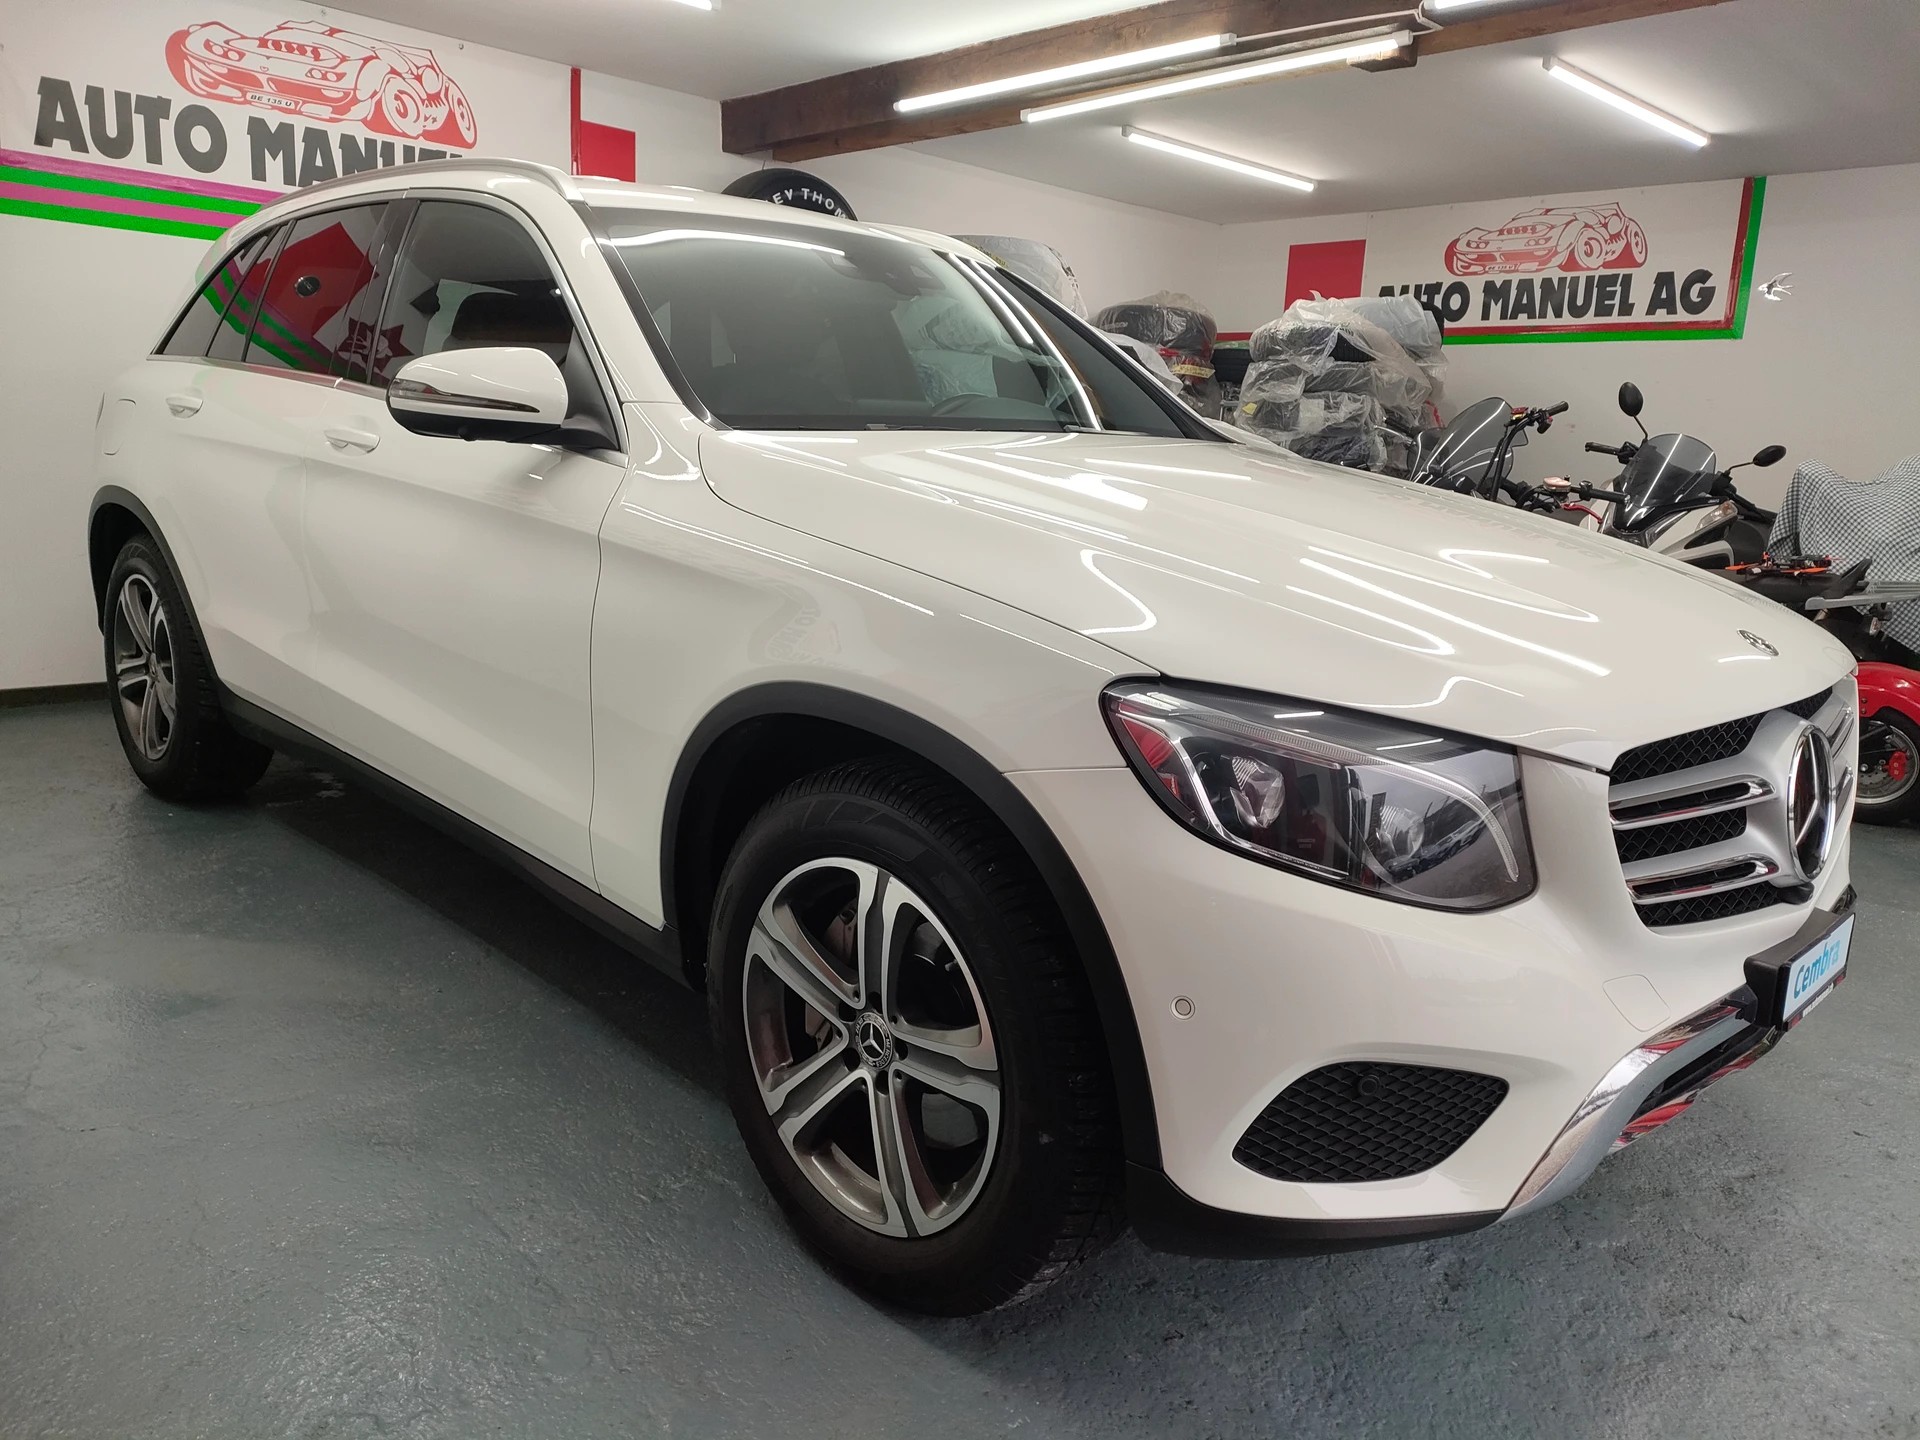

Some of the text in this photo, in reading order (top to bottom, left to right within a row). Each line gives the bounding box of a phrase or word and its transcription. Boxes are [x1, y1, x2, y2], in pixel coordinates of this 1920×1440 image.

[34, 76, 463, 188] AUTO MAN
[1481, 273, 1636, 321] MANUEL
[1645, 269, 1717, 316] AG
[1793, 939, 1841, 999] Cembra
